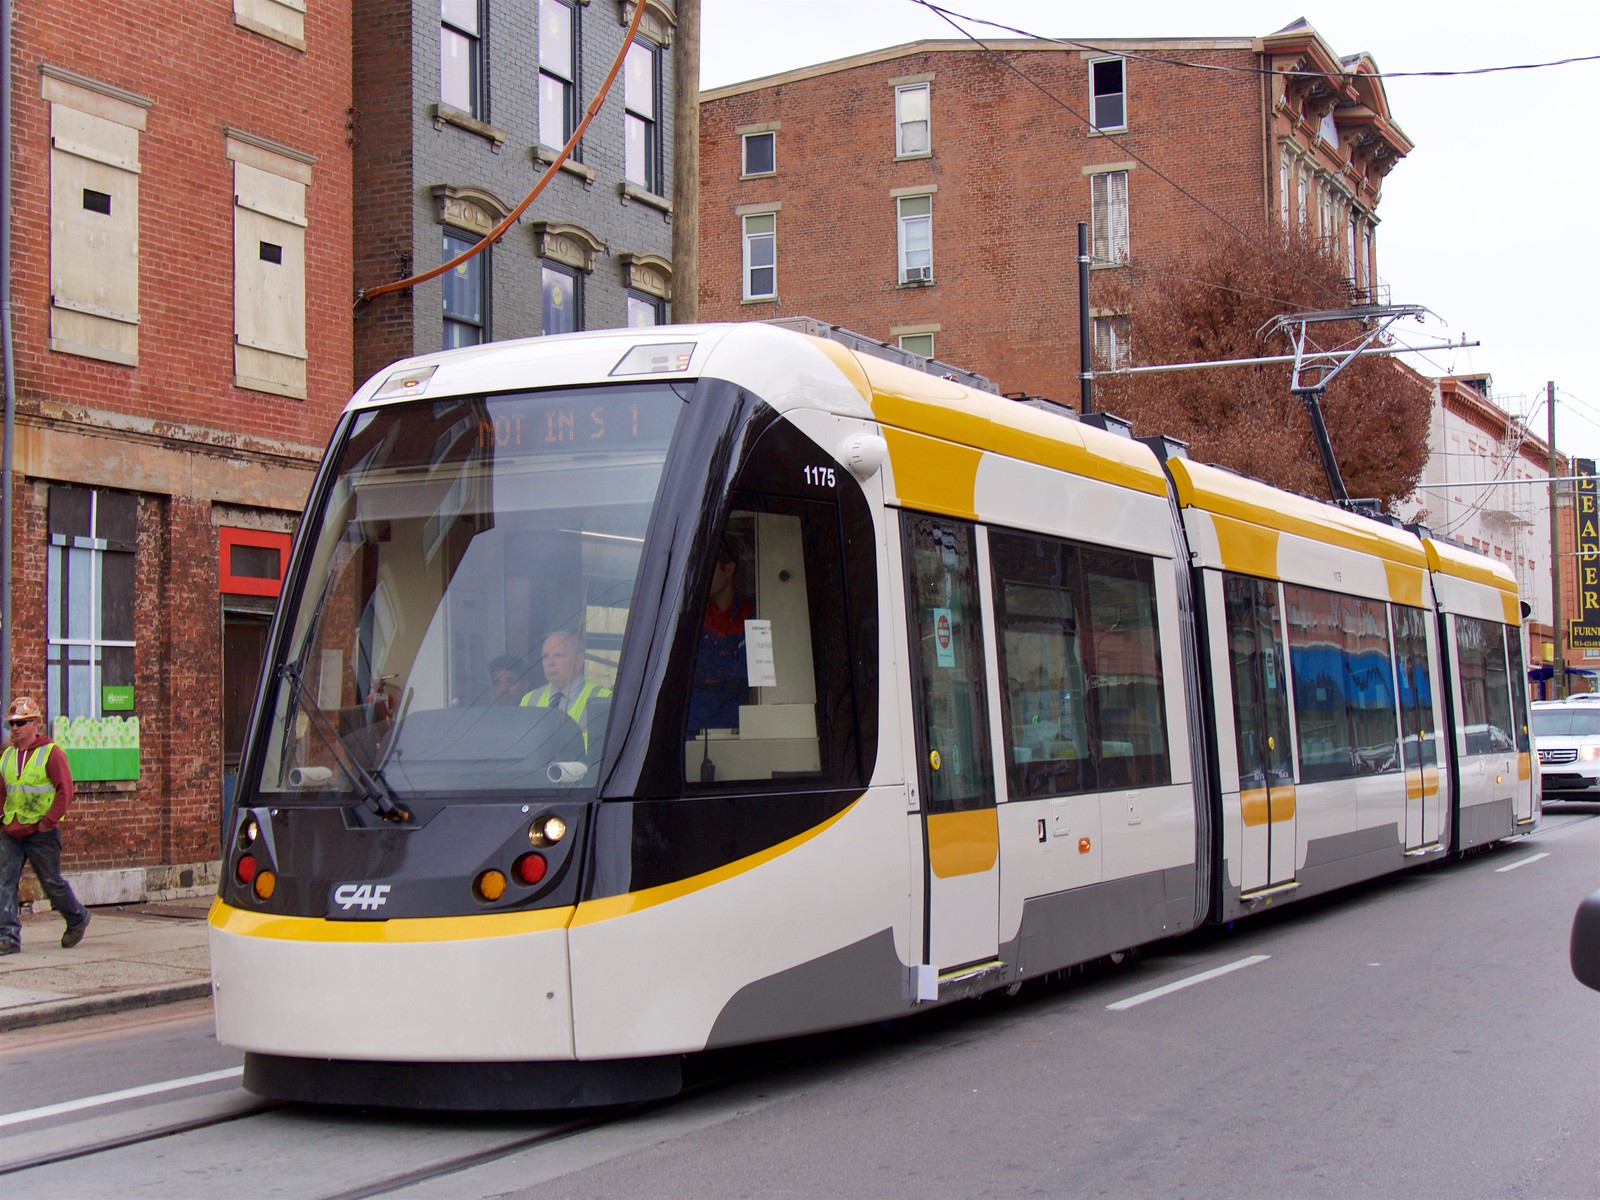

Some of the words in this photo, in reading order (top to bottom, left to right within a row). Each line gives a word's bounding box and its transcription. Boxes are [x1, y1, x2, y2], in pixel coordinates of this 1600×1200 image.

[479, 413, 527, 448] NOT
[544, 410, 575, 442] IN
[804, 465, 836, 488] 1175
[1580, 471, 1600, 609] LEADER
[334, 884, 392, 911] CAF
